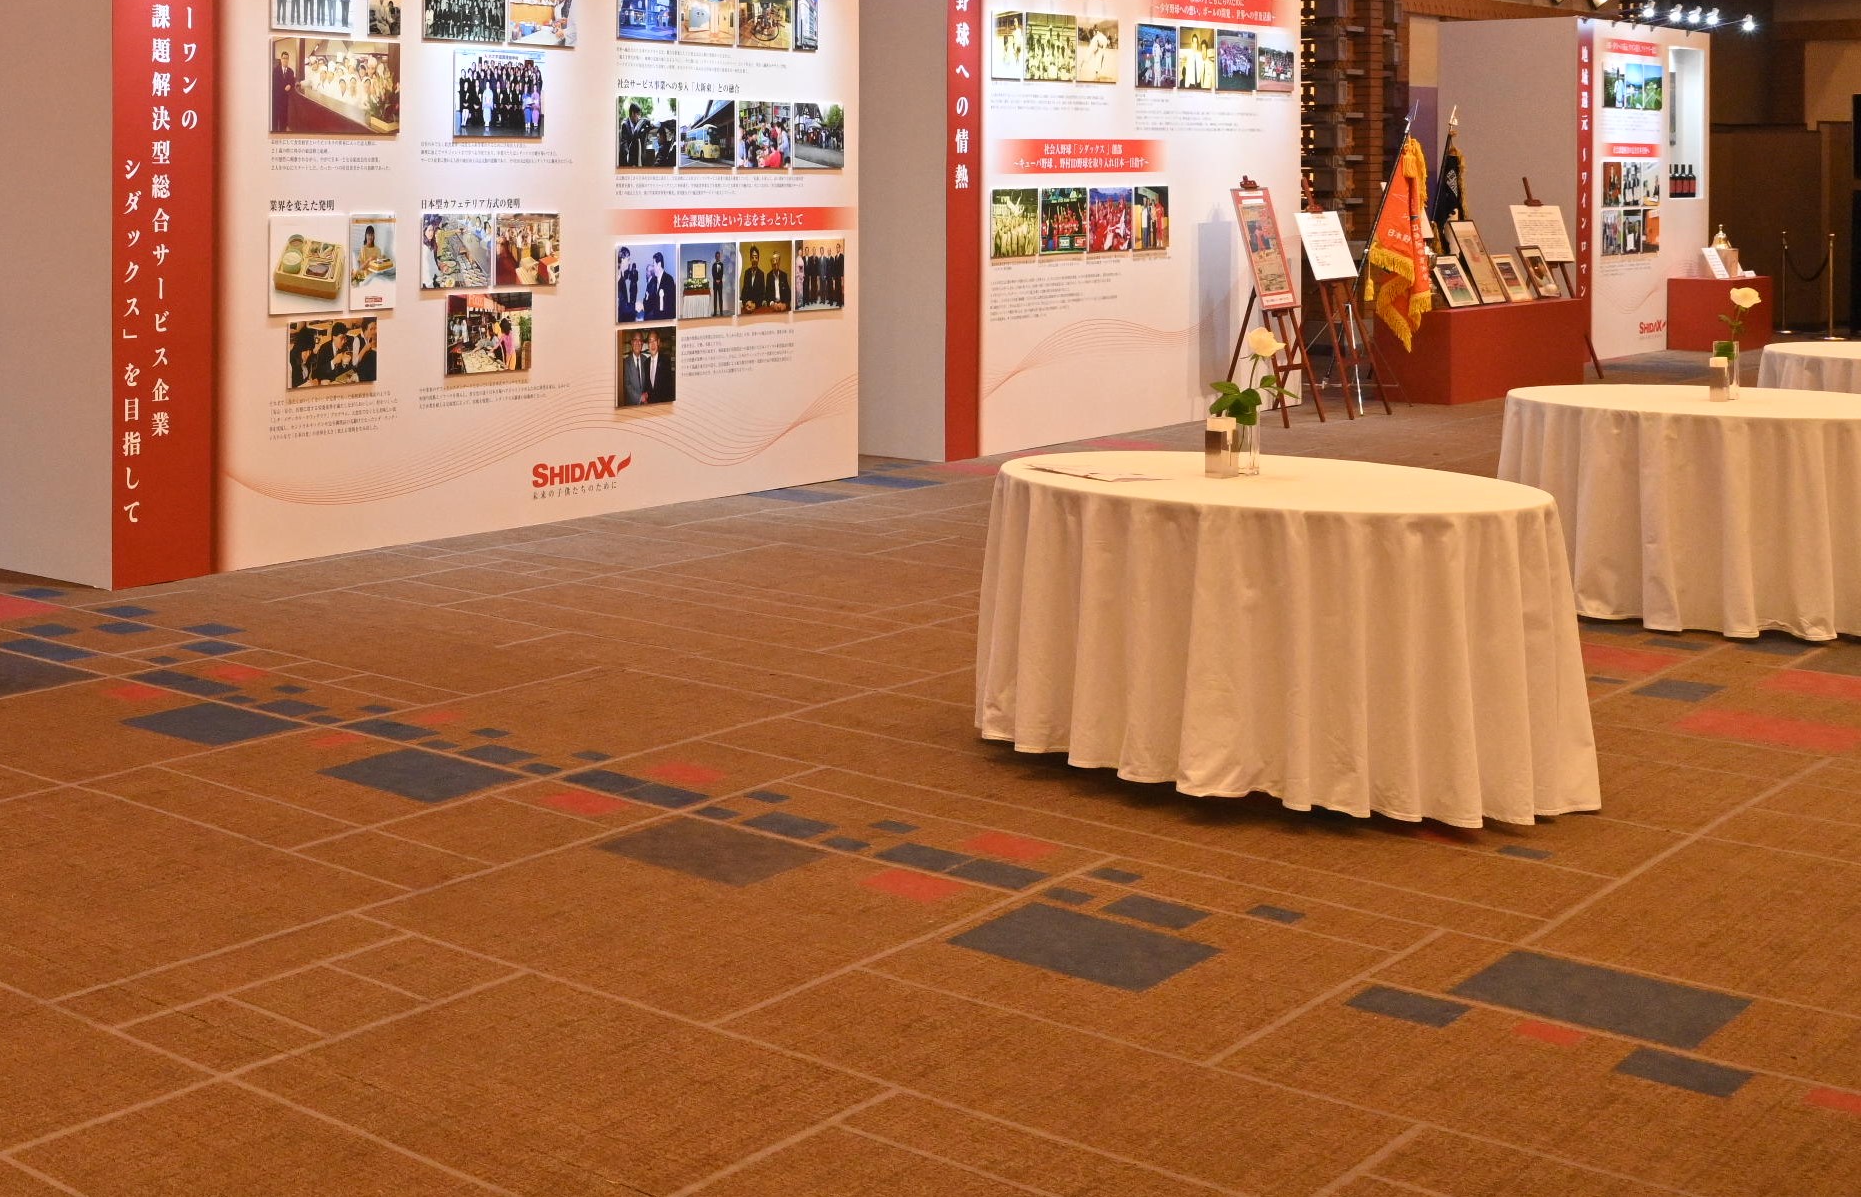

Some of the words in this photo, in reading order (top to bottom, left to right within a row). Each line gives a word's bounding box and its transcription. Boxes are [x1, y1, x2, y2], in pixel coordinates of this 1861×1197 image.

[269, 199, 335, 212] 業界を変えた発明
[421, 198, 521, 210] 日本型カフェテリア方式の発明
[673, 213, 804, 228] 社会課題解決という志をまっとうして
[122, 159, 142, 523] シダックス」を目指して
[532, 455, 617, 488] SHIDAX
